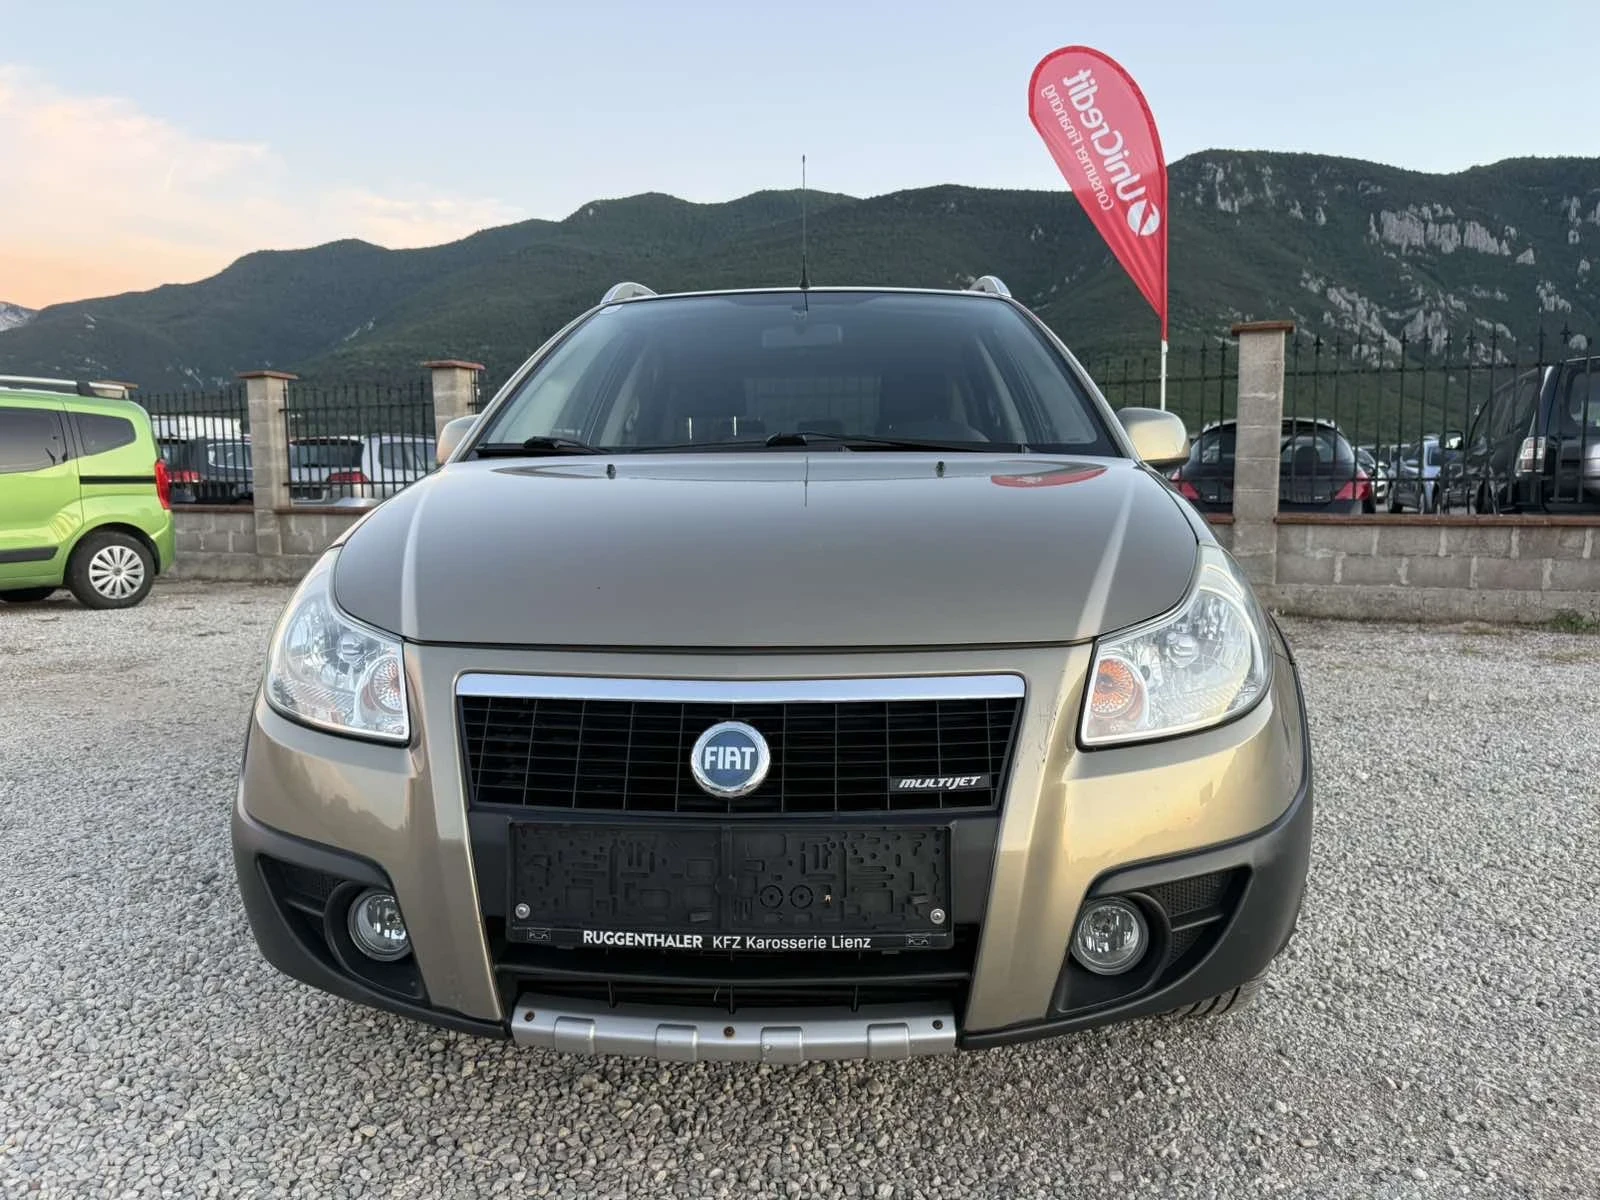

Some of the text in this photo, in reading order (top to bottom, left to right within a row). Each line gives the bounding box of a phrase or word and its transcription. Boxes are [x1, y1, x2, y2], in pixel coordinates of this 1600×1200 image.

[704, 746, 756, 770] FIAT
[898, 775, 981, 790] MULTIJET
[583, 930, 871, 949] RUGGENTHALER KFZ Karosserie Lienz
